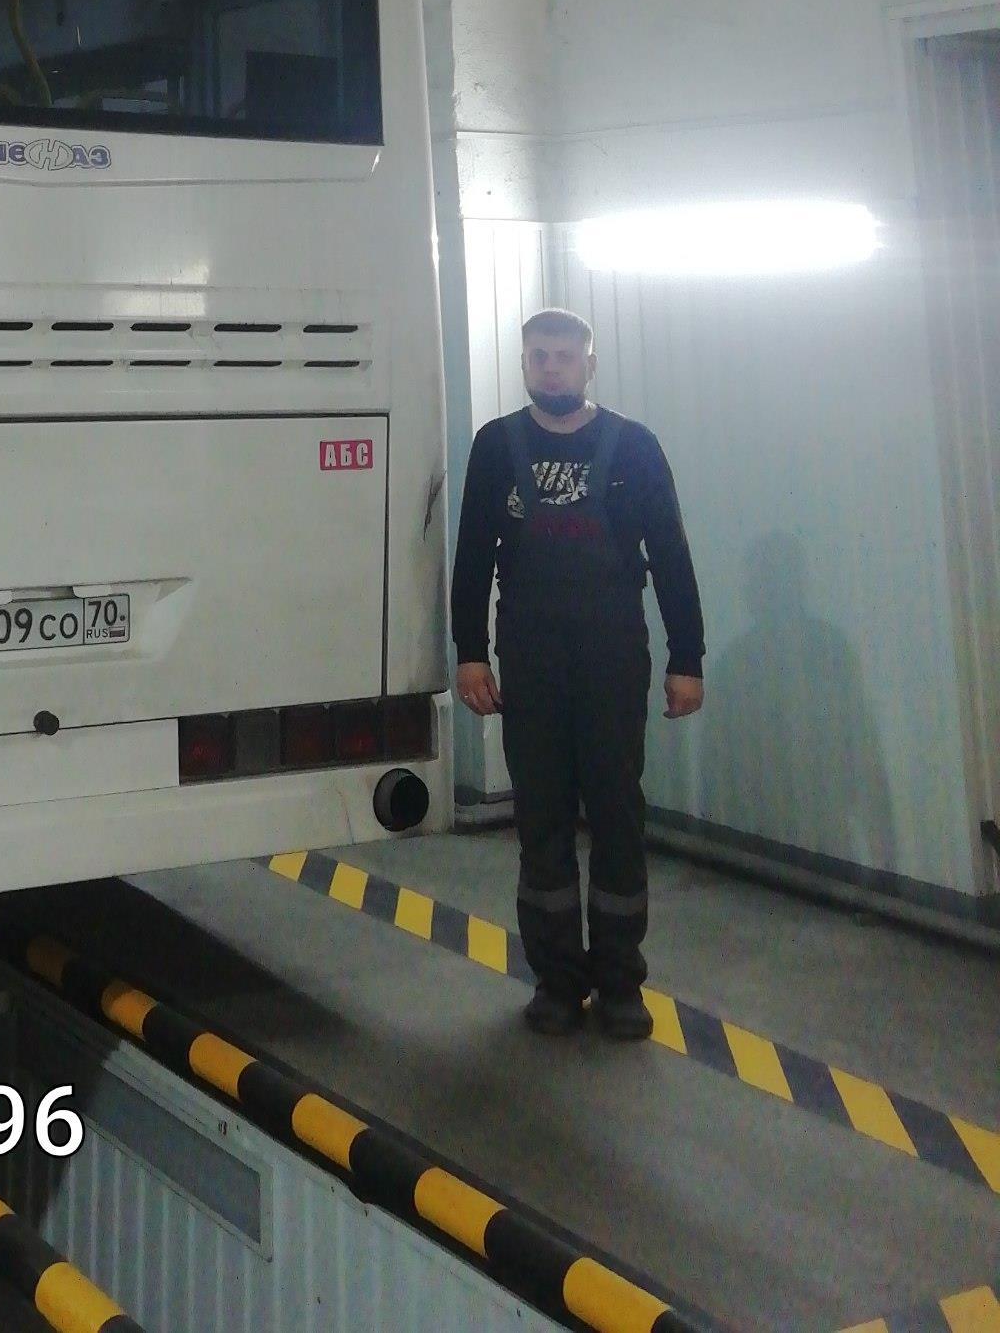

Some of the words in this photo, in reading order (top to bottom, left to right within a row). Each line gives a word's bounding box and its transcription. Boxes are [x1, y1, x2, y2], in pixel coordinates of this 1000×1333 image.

[324, 442, 368, 467] АБС
[87, 599, 118, 628] 70
[86, 628, 109, 640] RUS
